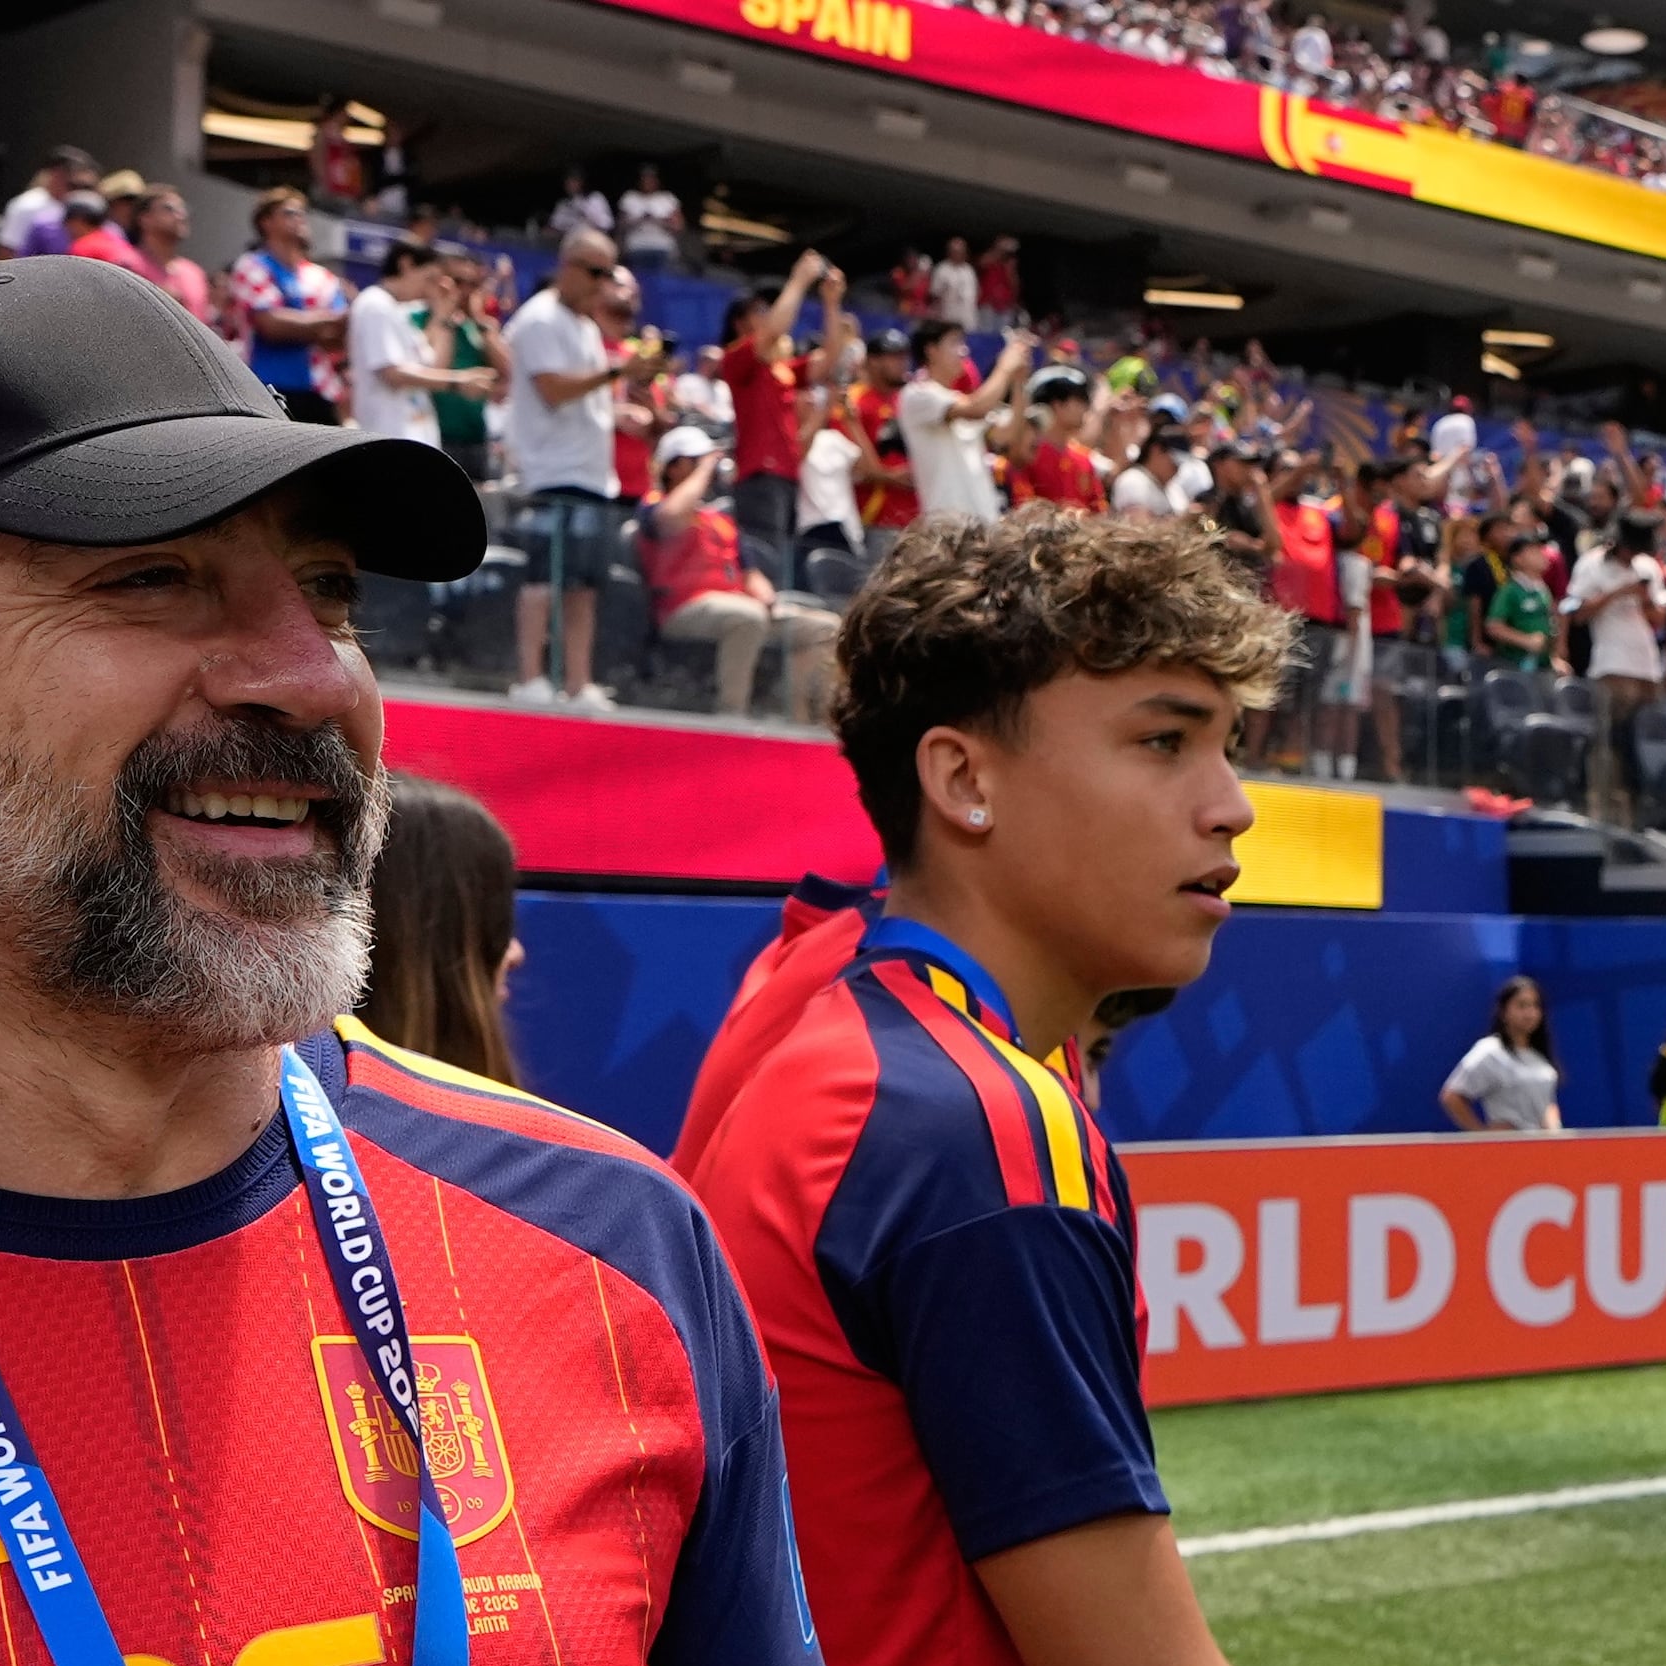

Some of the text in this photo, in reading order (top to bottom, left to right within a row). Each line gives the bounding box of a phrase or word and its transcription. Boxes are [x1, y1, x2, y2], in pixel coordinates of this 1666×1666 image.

[739, 0, 912, 62] SPAIN
[287, 1074, 420, 1438] FIFA WORLD CUP 202
[1139, 1191, 1456, 1355] RLD
[466, 1497, 484, 1510] 09
[10, 1500, 73, 1593] FIFA
[383, 1573, 543, 1606] SPAI AUDI ARABIA
[482, 1594, 519, 1613] 2026
[467, 1615, 509, 1635] LANTA
